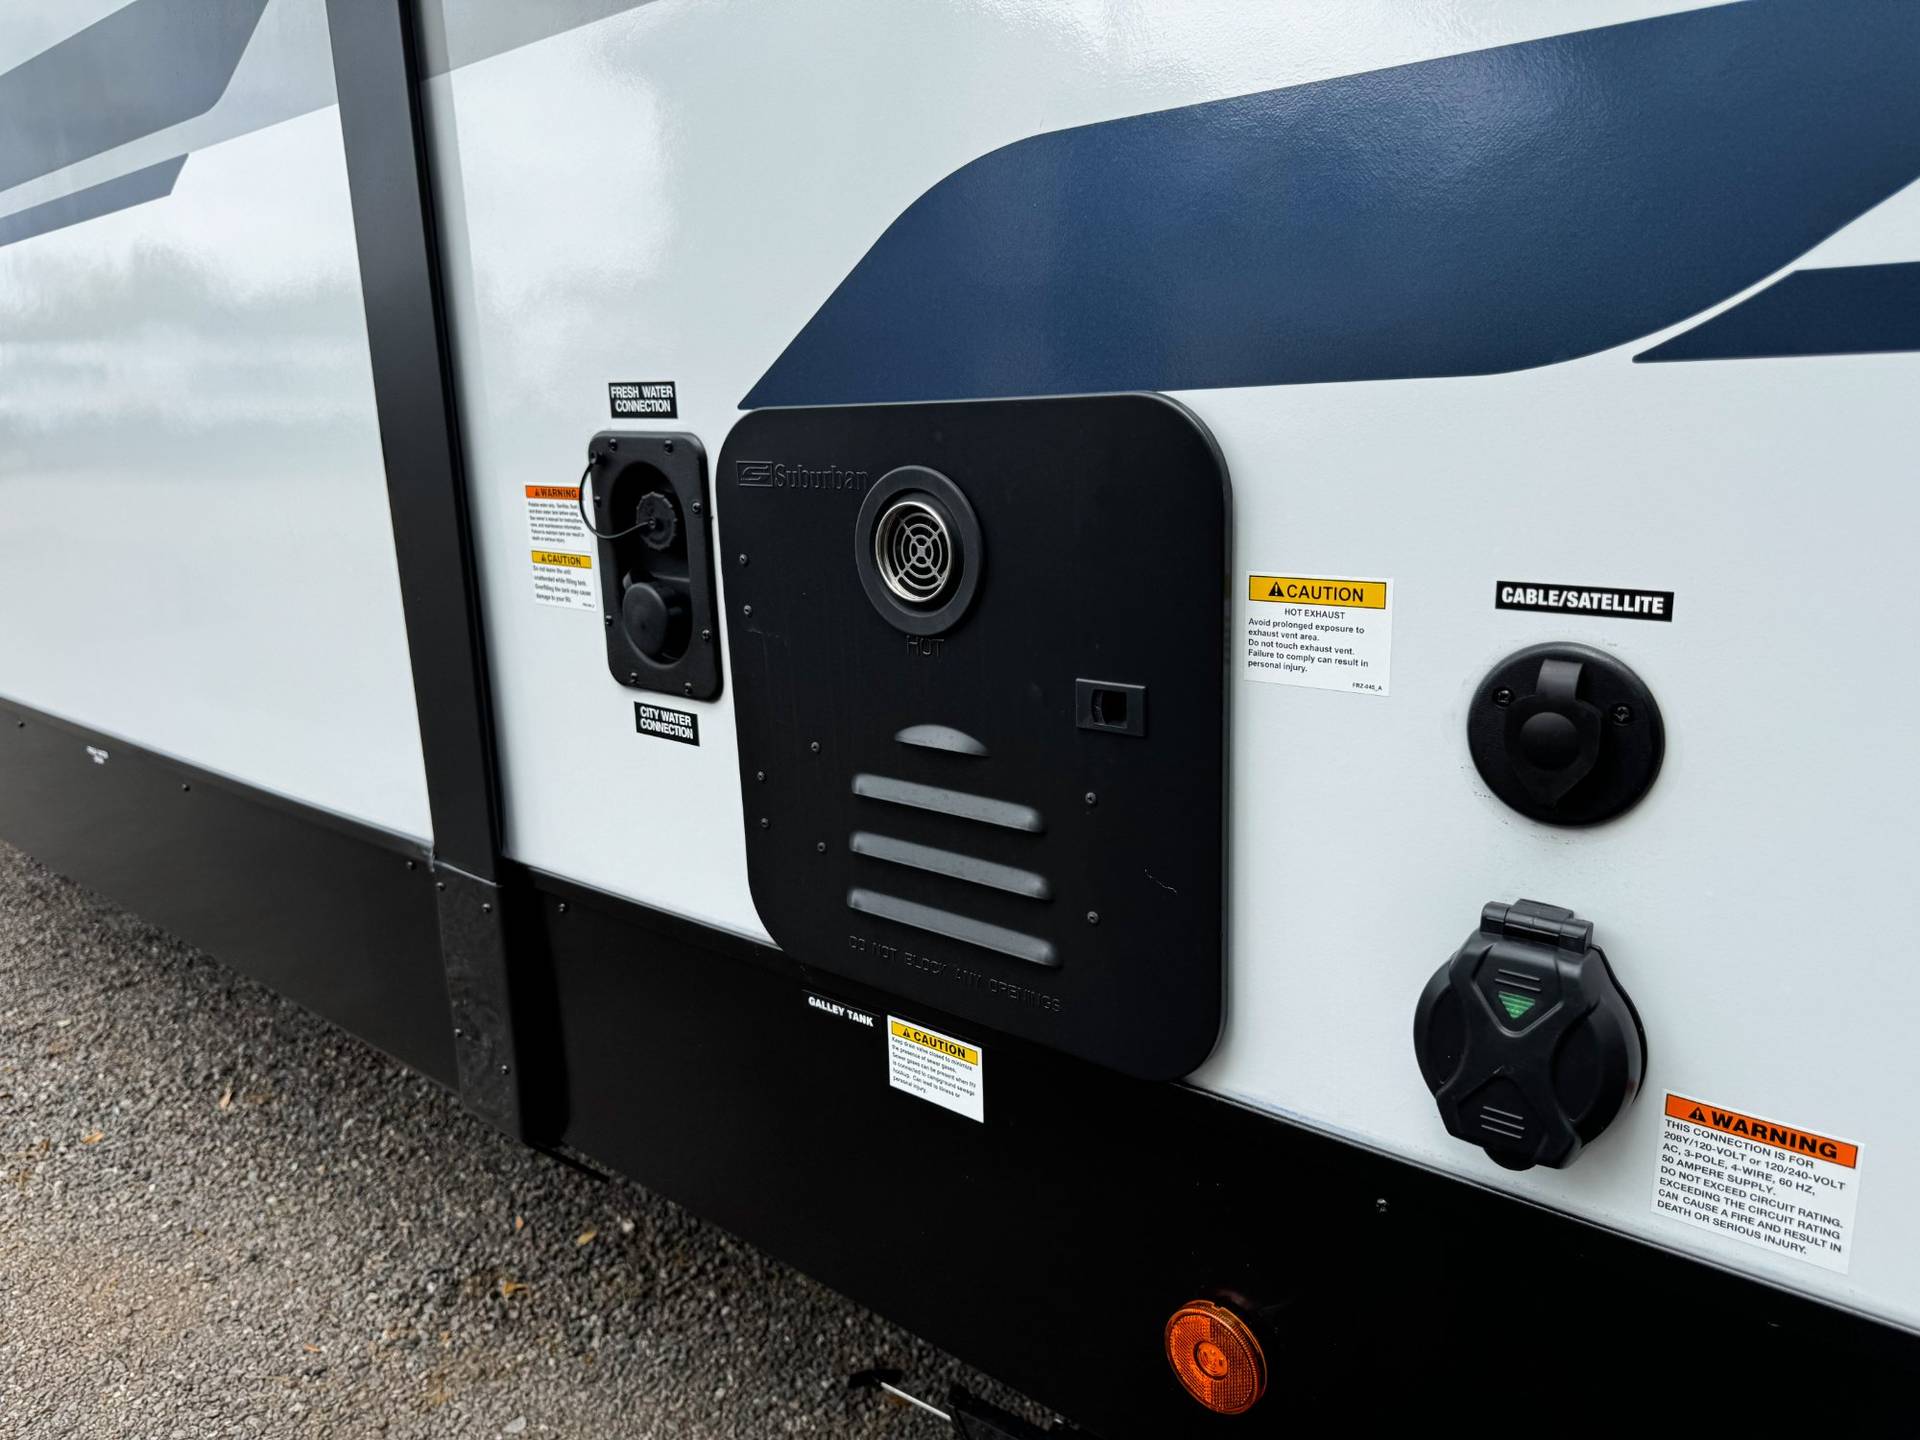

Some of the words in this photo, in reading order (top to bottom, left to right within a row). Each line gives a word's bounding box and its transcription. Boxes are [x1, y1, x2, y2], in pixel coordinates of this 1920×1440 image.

[610, 386, 639, 398] FRESH
[642, 386, 674, 398] WATER
[616, 400, 670, 412] CONNECTION
[775, 463, 868, 490] Suburban
[540, 488, 577, 498] WARNING
[547, 554, 582, 566] CAUTION
[1287, 584, 1364, 602] CAUTION
[1502, 586, 1664, 614] CABLE/SATELLITE
[1284, 608, 1302, 616] HOT
[1304, 610, 1346, 620] EXHAUST
[1248, 618, 1270, 626] Avoid
[1272, 620, 1312, 630] prolonged
[1315, 624, 1354, 634] exposure
[1356, 626, 1364, 634] to
[1248, 630, 1278, 638] exhaust
[905, 636, 944, 656] HOT
[1248, 638, 1259, 646] Do
[1276, 641, 1298, 650] touch
[1300, 644, 1332, 653] exhaust
[1248, 648, 1274, 658] Failure
[1286, 653, 1315, 664] comply
[1334, 658, 1358, 666] result
[1248, 660, 1281, 669] personal
[1283, 662, 1308, 672] injury.
[640, 706, 660, 720] CITY
[660, 710, 692, 726] WATER
[641, 718, 694, 739] CONNECTION
[808, 996, 845, 1016] GALLEY
[847, 1009, 874, 1026] TANK
[914, 1032, 966, 1058] CAUTION
[1665, 1119, 1690, 1132] THIS
[1694, 1128, 1770, 1157] CONNECTION
[1774, 1151, 1786, 1160] IS
[1789, 1156, 1814, 1168] FOR
[1712, 1110, 1838, 1159] WARNING
[1663, 1143, 1681, 1156] AC,
[1684, 1149, 1728, 1170] 3-POLE,
[1731, 1164, 1776, 1184] 4-WIRE,
[1779, 1178, 1792, 1188] 60
[1796, 1182, 1816, 1196] HZ,
[1664, 1131, 1746, 1161] 208Y/120-VOLT
[1749, 1158, 1761, 1166] or
[1765, 1162, 1846, 1190] 120/240-VOLT
[1662, 1154, 1674, 1164] 50
[1676, 1160, 1724, 1180] AMPERE
[1727, 1174, 1776, 1196] SUPPLY.
[1661, 1165, 1676, 1176] DO
[1679, 1171, 1700, 1184] NOT
[1704, 1178, 1746, 1198] EXCEED
[1750, 1193, 1796, 1213] CIRCUIT
[1798, 1208, 1844, 1228] RATING.
[1660, 1177, 1721, 1202] EXCEEDING
[1724, 1196, 1746, 1210] THE
[1748, 1205, 1794, 1225] CIRCUIT
[1798, 1220, 1840, 1240] RATING
[1658, 1188, 1678, 1200] CAN
[1683, 1196, 1718, 1214] CAUSE
[1721, 1208, 1728, 1217] A
[1731, 1212, 1755, 1226] FIRE
[1757, 1220, 1781, 1234] AND
[1784, 1228, 1828, 1248] RESULT
[1830, 1242, 1842, 1253] IN
[1658, 1200, 1692, 1218] DEATH
[1694, 1212, 1710, 1223] OR
[1712, 1218, 1760, 1240] SERIOUS
[1764, 1234, 1806, 1254] INJURY.
